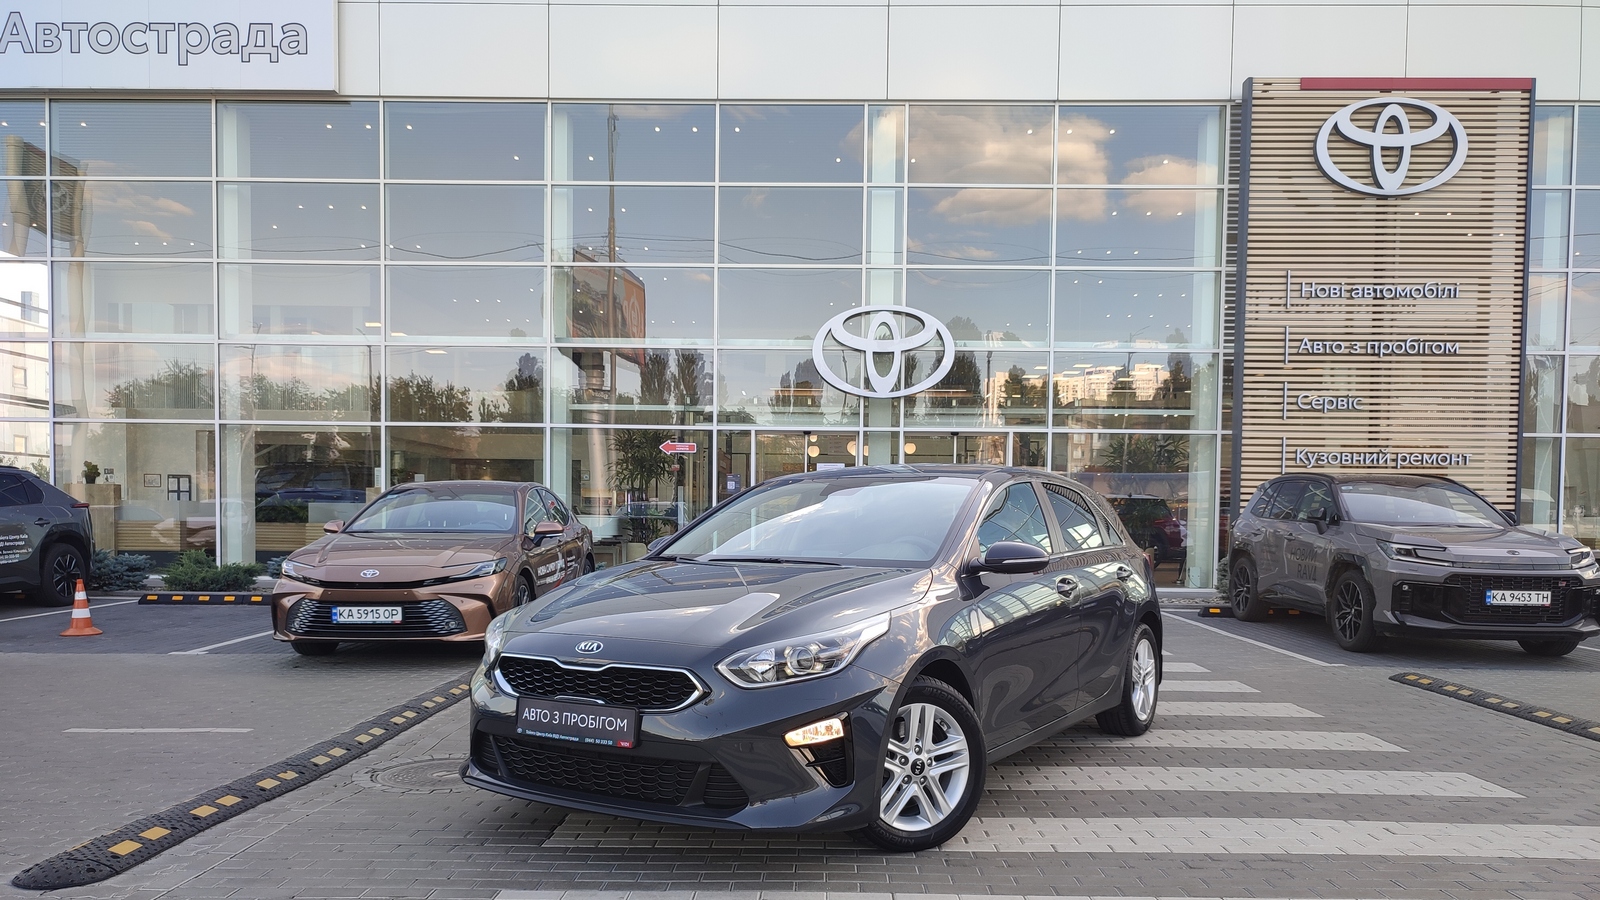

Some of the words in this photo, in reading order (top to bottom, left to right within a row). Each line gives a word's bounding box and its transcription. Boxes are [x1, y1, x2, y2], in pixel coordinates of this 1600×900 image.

[0, 11, 308, 65] Автострада
[1300, 281, 1346, 299] Нові
[1351, 281, 1460, 299] автомобілі
[1297, 337, 1344, 354] Авто
[1349, 342, 1360, 354] з
[1366, 337, 1460, 358] пробігом
[1296, 393, 1364, 414] Сервіс
[1295, 447, 1390, 469] Кузовний
[1396, 451, 1472, 469] ремонт
[1296, 563, 1317, 583] RAV4
[1492, 592, 1507, 602] KA
[1509, 592, 1532, 602] 9453
[1534, 593, 1549, 602] TH
[338, 608, 354, 619] KA
[356, 608, 381, 619] 5915
[383, 608, 399, 619] OP
[578, 641, 598, 651] KIA
[522, 707, 550, 723] АВТО
[552, 711, 560, 724] З
[562, 712, 628, 732] ПРОБІГОМ
[914, 759, 923, 774] KIA
